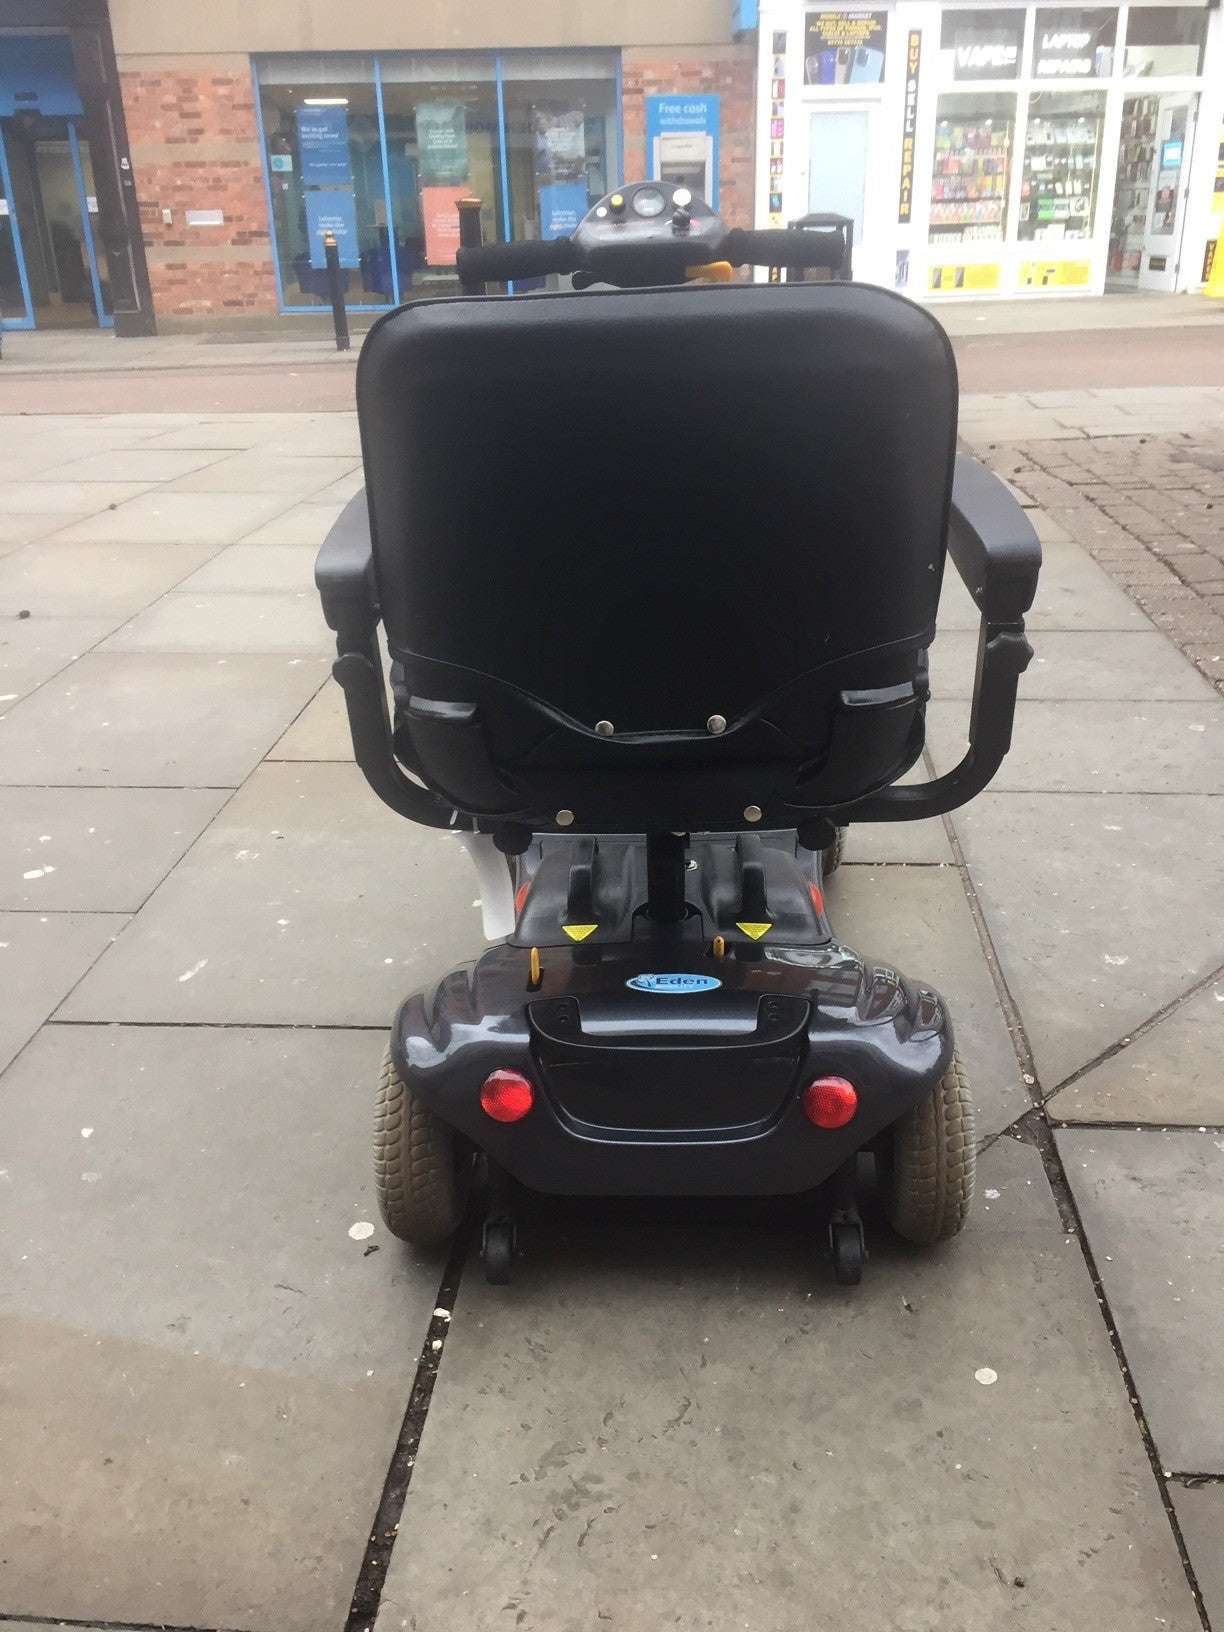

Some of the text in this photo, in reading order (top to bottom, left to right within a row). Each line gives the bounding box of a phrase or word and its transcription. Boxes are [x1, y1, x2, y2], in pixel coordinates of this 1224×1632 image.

[659, 102, 707, 113] Free cash
[900, 34, 919, 215] BUY SELL REPAIR
[656, 977, 708, 985] Eden
